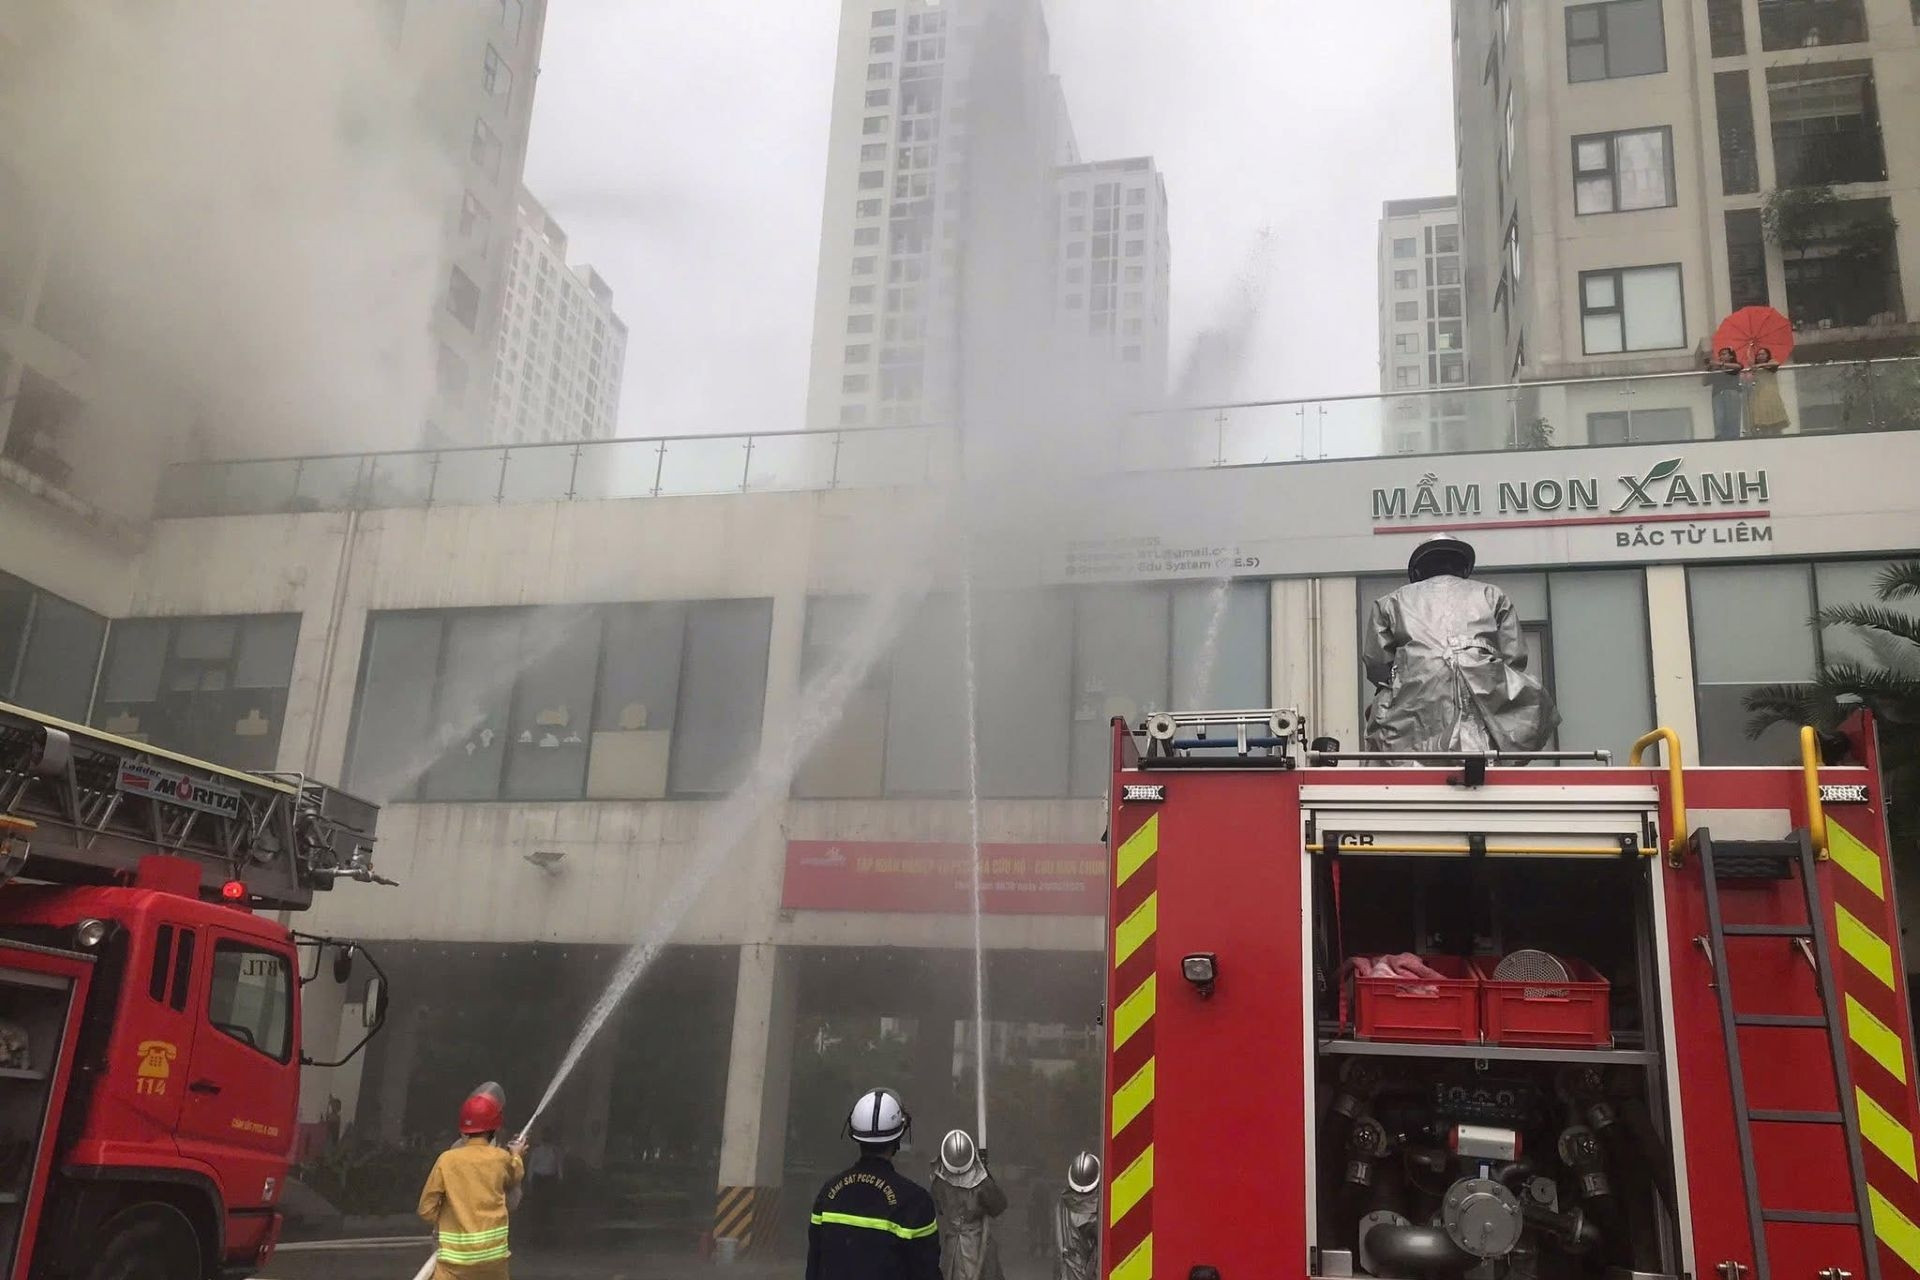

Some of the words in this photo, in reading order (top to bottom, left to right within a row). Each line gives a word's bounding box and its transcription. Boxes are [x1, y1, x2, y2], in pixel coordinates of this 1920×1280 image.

[1372, 472, 1481, 518] MẦM
[1498, 478, 1600, 513] NON
[1609, 459, 1769, 513] XANH
[1616, 524, 1664, 547] BẮC
[1671, 523, 1706, 545] TỪ
[1713, 521, 1773, 544] LIÊM
[137, 1078, 166, 1095] 114
